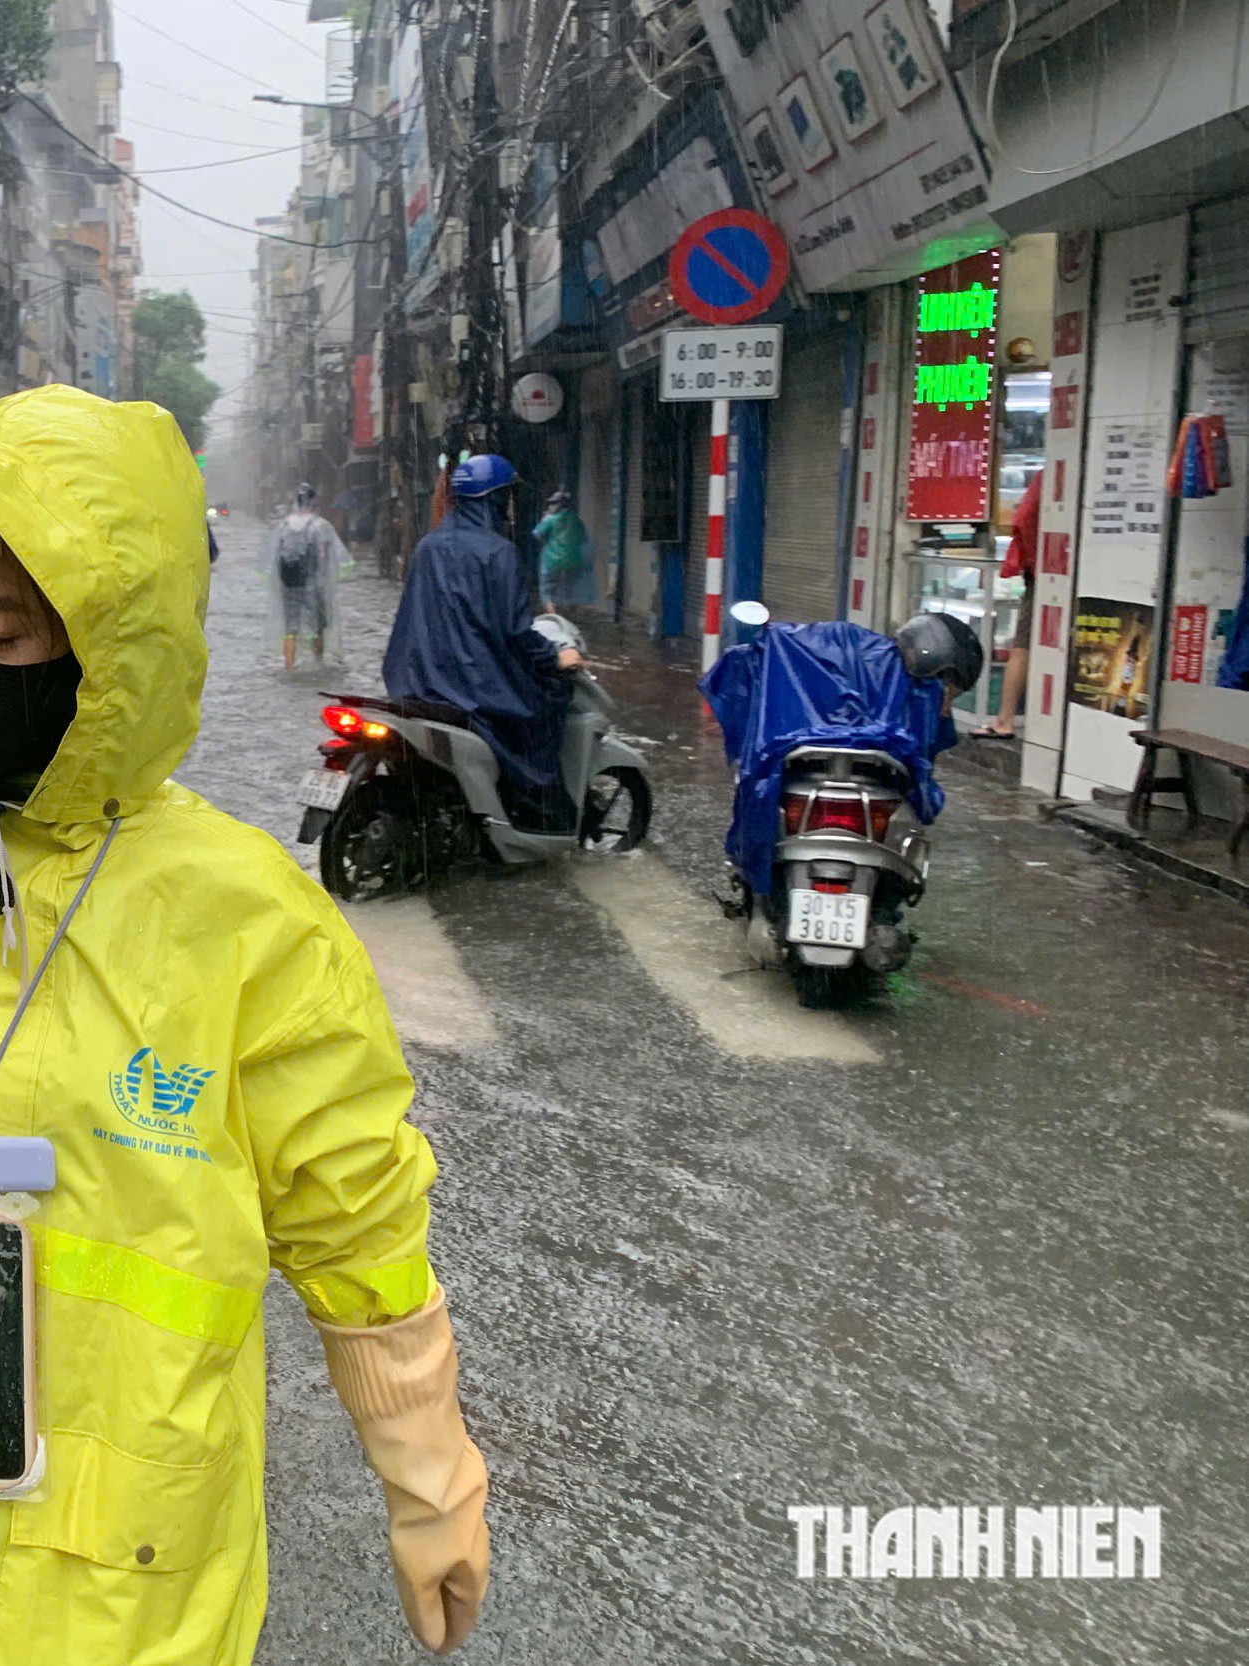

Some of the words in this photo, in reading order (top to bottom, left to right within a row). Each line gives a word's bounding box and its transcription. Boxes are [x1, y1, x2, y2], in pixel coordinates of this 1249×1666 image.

[799, 918, 854, 942] 3806
[109, 1133, 137, 1148] CHUNG
[139, 1140, 154, 1152] TAY
